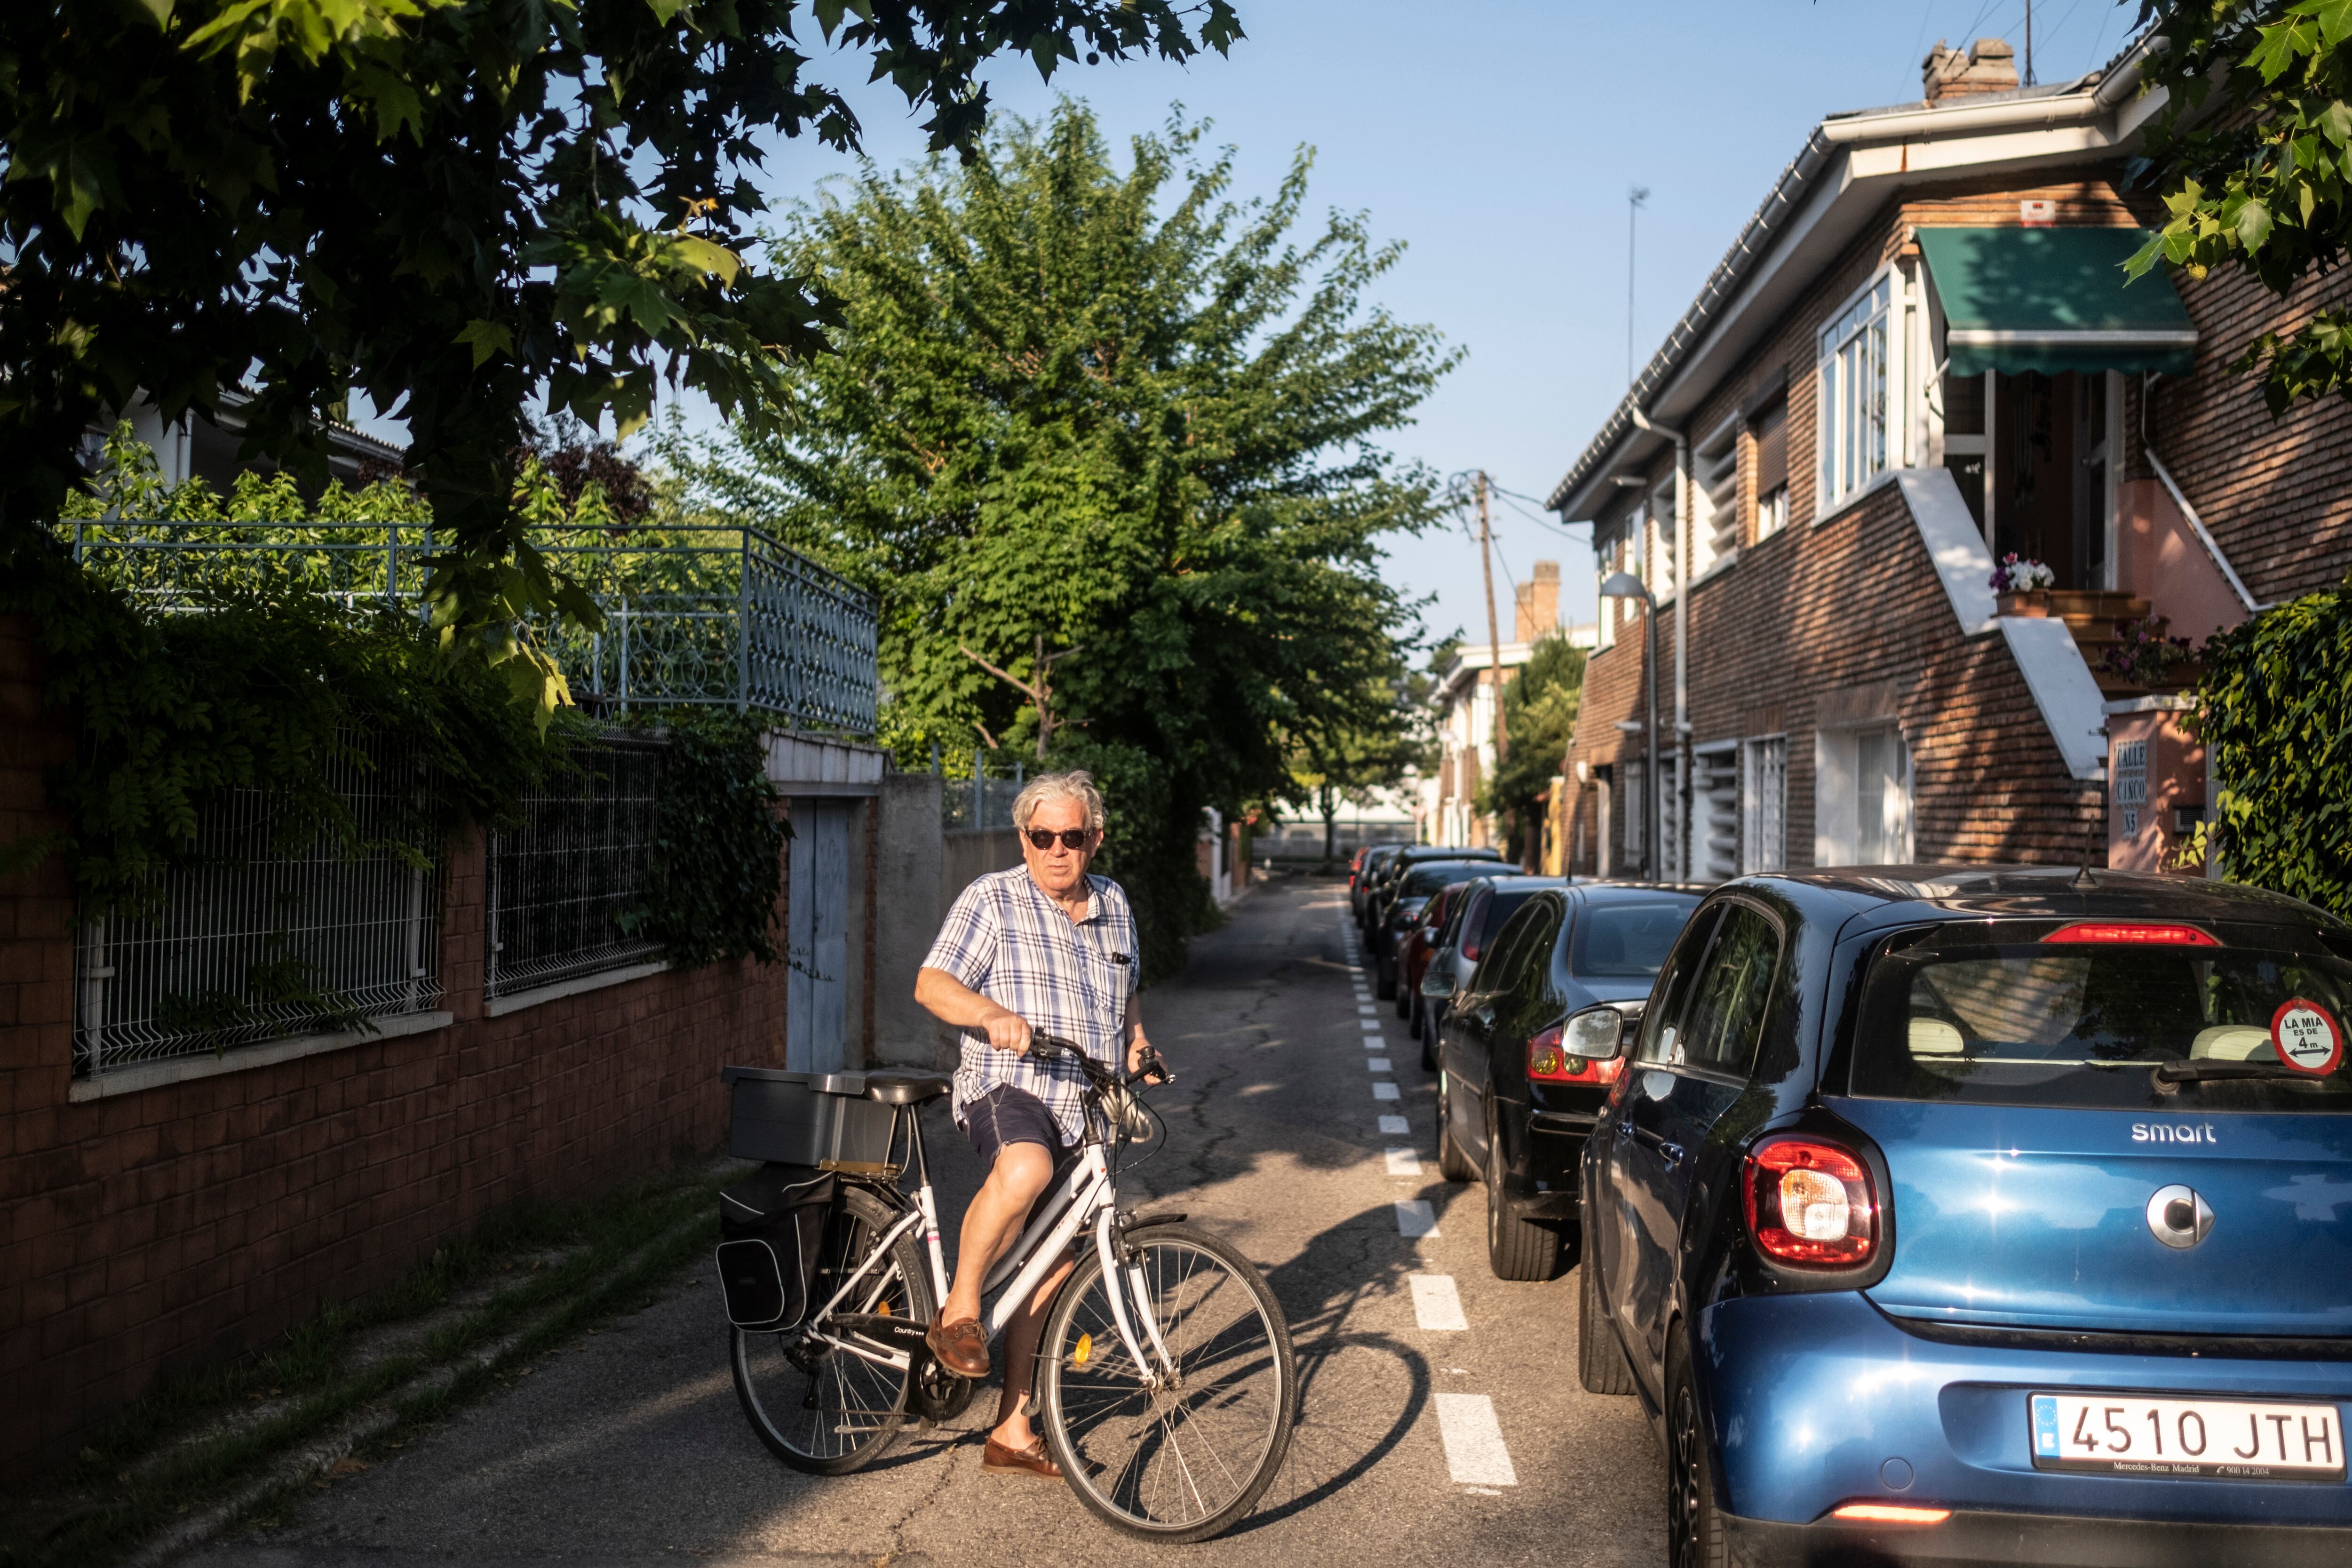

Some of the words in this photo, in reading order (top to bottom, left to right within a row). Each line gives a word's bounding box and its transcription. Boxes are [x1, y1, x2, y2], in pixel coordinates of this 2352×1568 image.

[2117, 746, 2145, 768] CALLE
[2117, 780, 2145, 800] CINCO
[2284, 1019, 2299, 1029] LA
[2301, 1017, 2323, 1028] MIA
[2299, 1037, 2308, 1048] 4
[2131, 1122, 2216, 1142] smart
[894, 1327, 915, 1336] Country
[2042, 1433, 2055, 1448] E
[2073, 1406, 2207, 1456] 4510
[2233, 1413, 2332, 1463] JTH
[2114, 1461, 2169, 1472] Mercedes-Benz
[2172, 1464, 2199, 1472] Madrid
